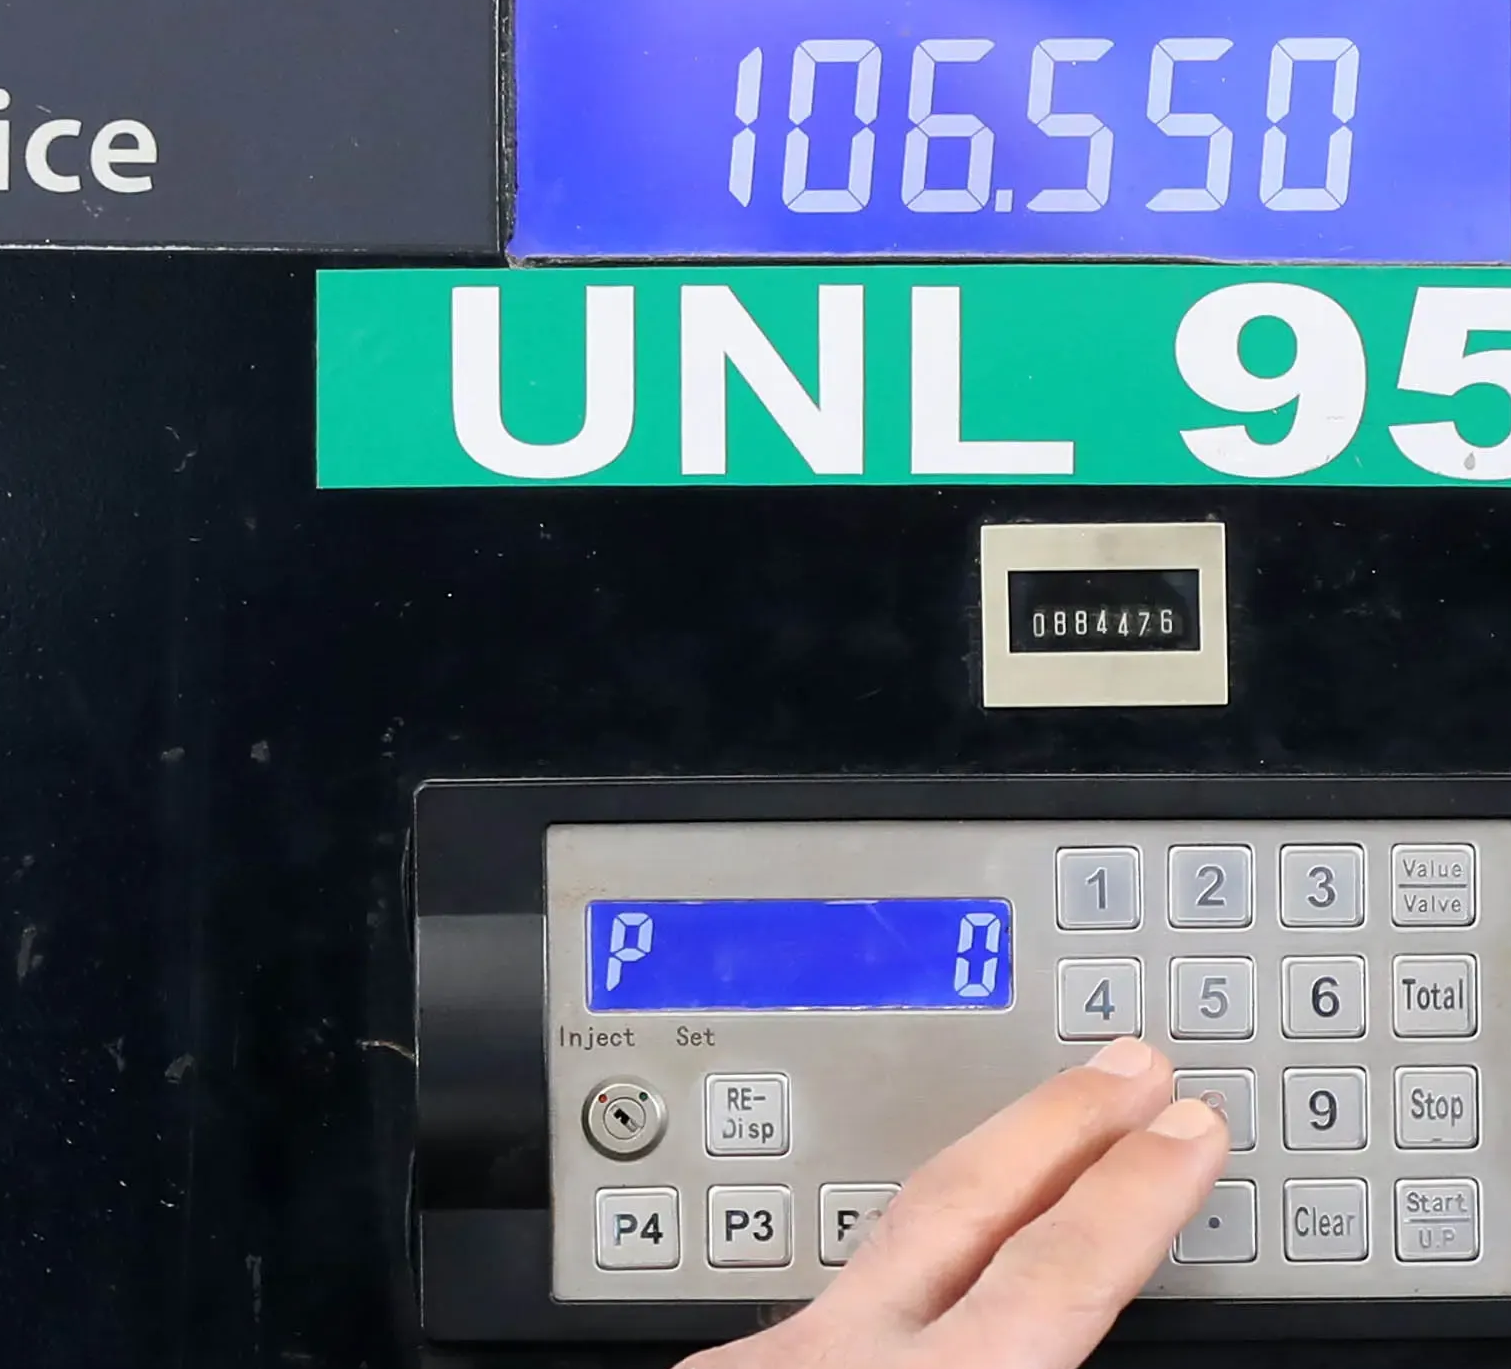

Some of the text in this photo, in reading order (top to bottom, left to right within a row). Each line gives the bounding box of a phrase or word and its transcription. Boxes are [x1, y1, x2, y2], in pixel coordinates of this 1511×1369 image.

[728, 37, 1360, 212] 106.550
[451, 284, 1076, 479] UNL
[1032, 609, 1174, 638] 0884476
[1402, 858, 1464, 879] Value
[1085, 868, 1107, 910] 1
[1195, 866, 1227, 907] 2
[1306, 866, 1337, 908] 3
[1403, 894, 1462, 914] Valve
[606, 912, 1001, 998] P 0
[1084, 978, 1115, 1020] 4
[1200, 977, 1230, 1019] 5
[1311, 977, 1341, 1019] 6
[1402, 978, 1465, 1011] Total
[559, 1025, 716, 1051] Inject Set
[727, 1087, 767, 1111] RE-
[1308, 1090, 1338, 1131] 9
[1410, 1089, 1465, 1127] Stop
[1406, 1191, 1469, 1213] Start
[613, 1213, 664, 1246] P4
[725, 1210, 775, 1243] P3
[1293, 1206, 1357, 1237] Clear
[1418, 1227, 1456, 1249] U.P
